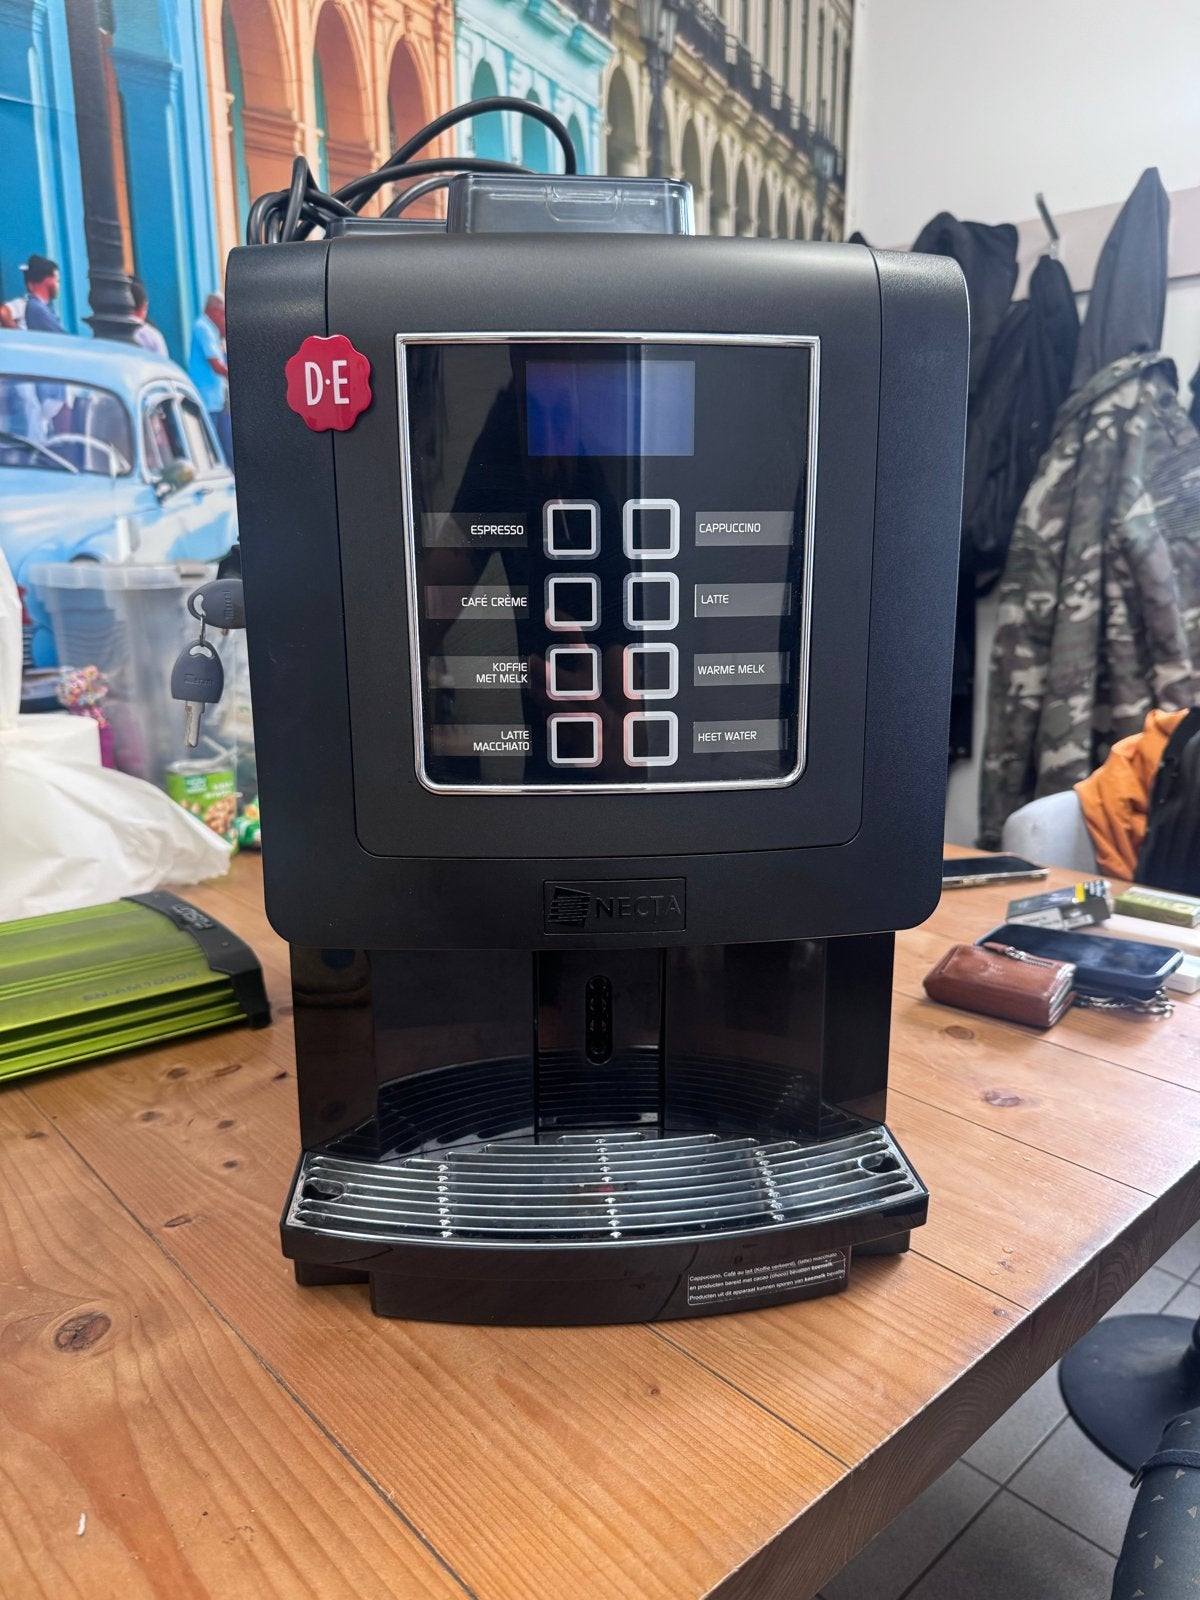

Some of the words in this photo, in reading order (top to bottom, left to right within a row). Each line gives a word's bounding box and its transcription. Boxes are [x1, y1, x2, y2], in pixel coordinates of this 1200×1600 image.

[470, 525, 524, 535] ESPRESSO
[699, 523, 761, 533] CAPPUCCINO
[461, 594, 488, 607] CAFÉ
[491, 594, 528, 607] CRÈME
[701, 594, 729, 604] LATTE
[492, 662, 528, 672] KOFFIE
[697, 665, 735, 675] WARME
[738, 664, 765, 674] MELK
[476, 674, 497, 683] MET
[499, 674, 528, 683] MELK
[501, 730, 530, 740] LATTE
[698, 732, 722, 742] HEET
[724, 731, 757, 741] WATER
[473, 742, 530, 751] MACCHIATO
[595, 895, 681, 918] NECTA
[689, 1273, 722, 1281] Cappuccino,
[697, 1282, 724, 1290] producten
[689, 1292, 716, 1300] Producten
